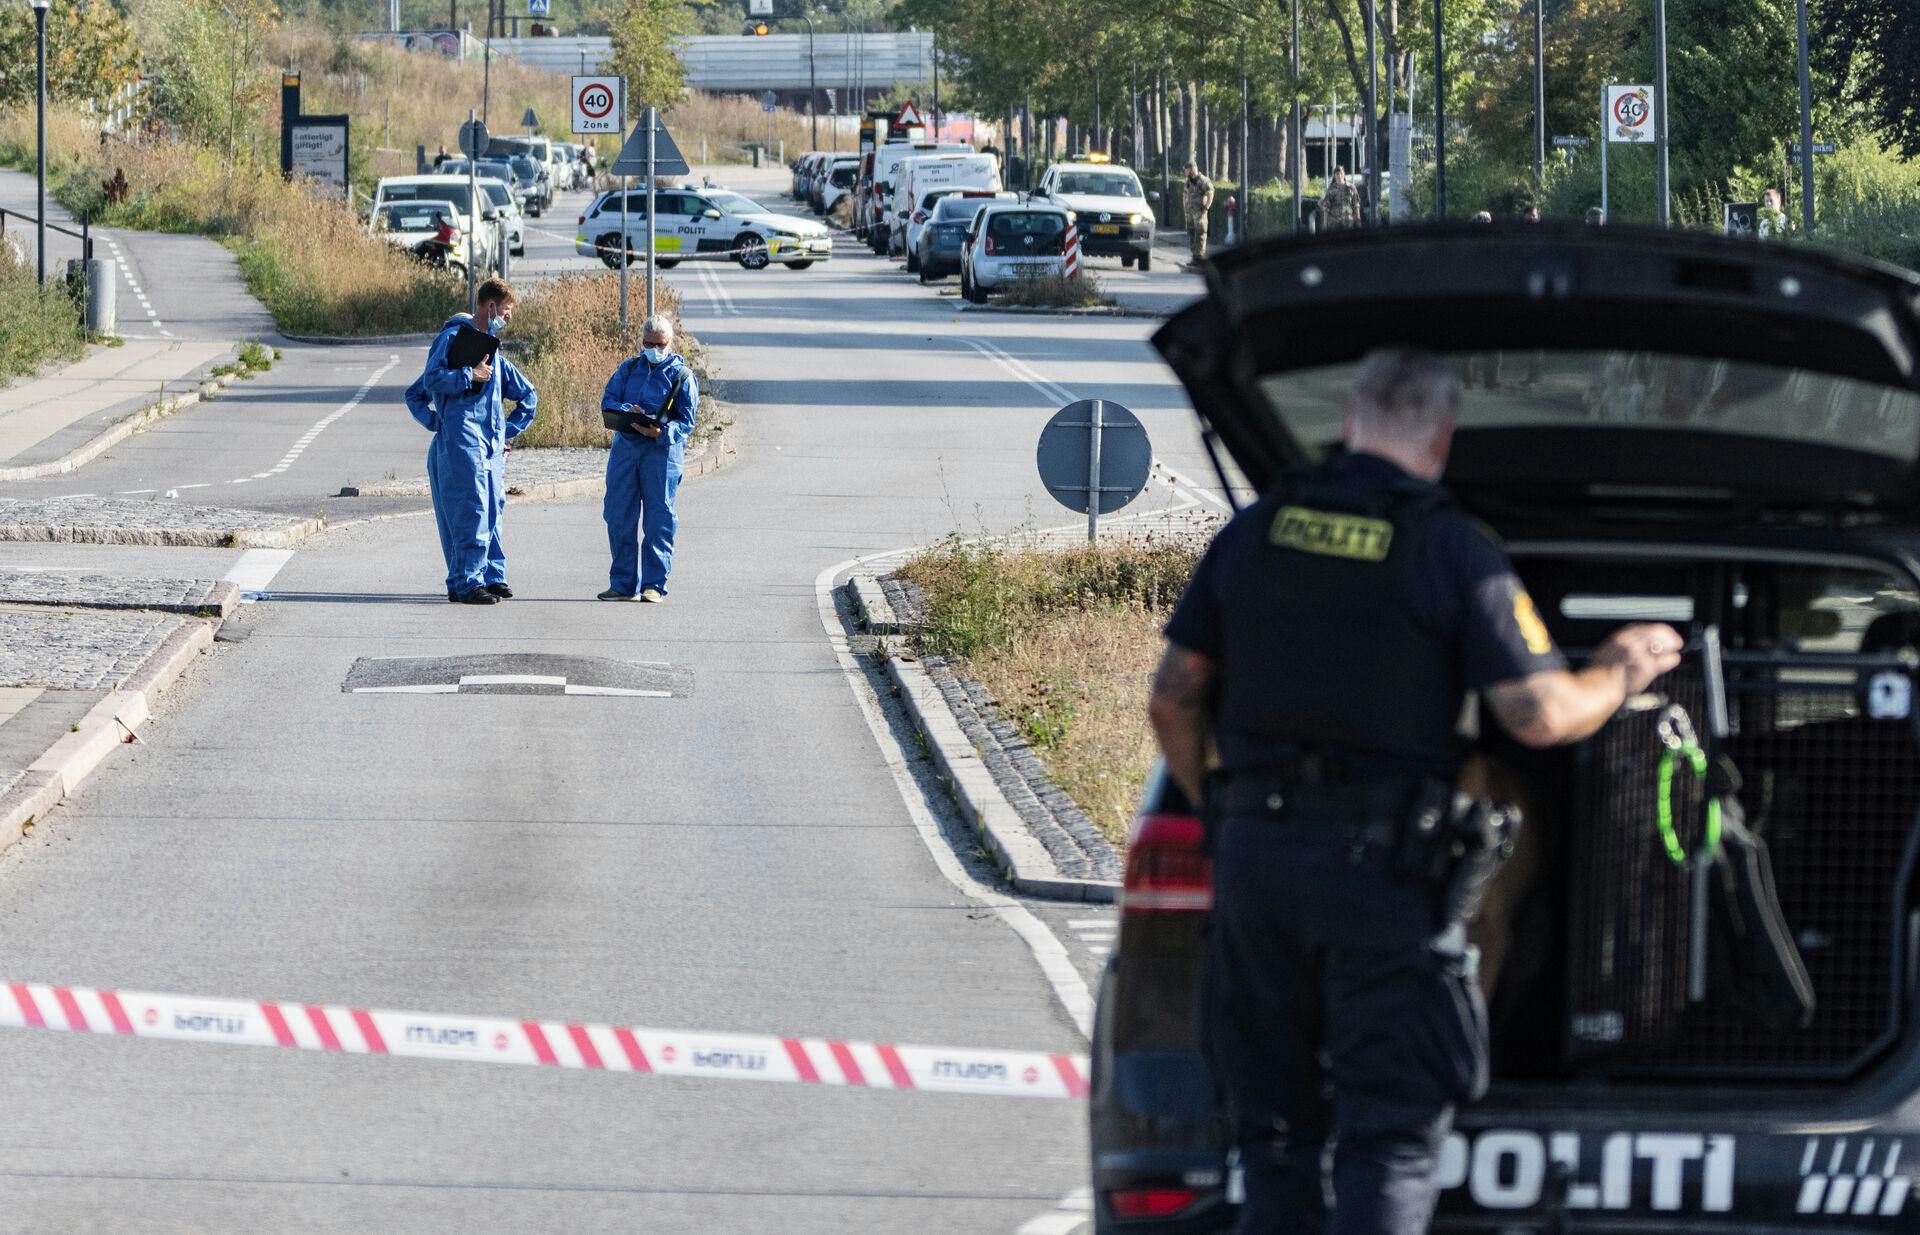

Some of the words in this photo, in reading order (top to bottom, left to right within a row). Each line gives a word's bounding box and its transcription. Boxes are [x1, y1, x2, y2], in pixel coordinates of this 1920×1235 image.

[585, 94, 607, 107] 40
[583, 120, 609, 129] Zone
[677, 225, 706, 235] POLITI
